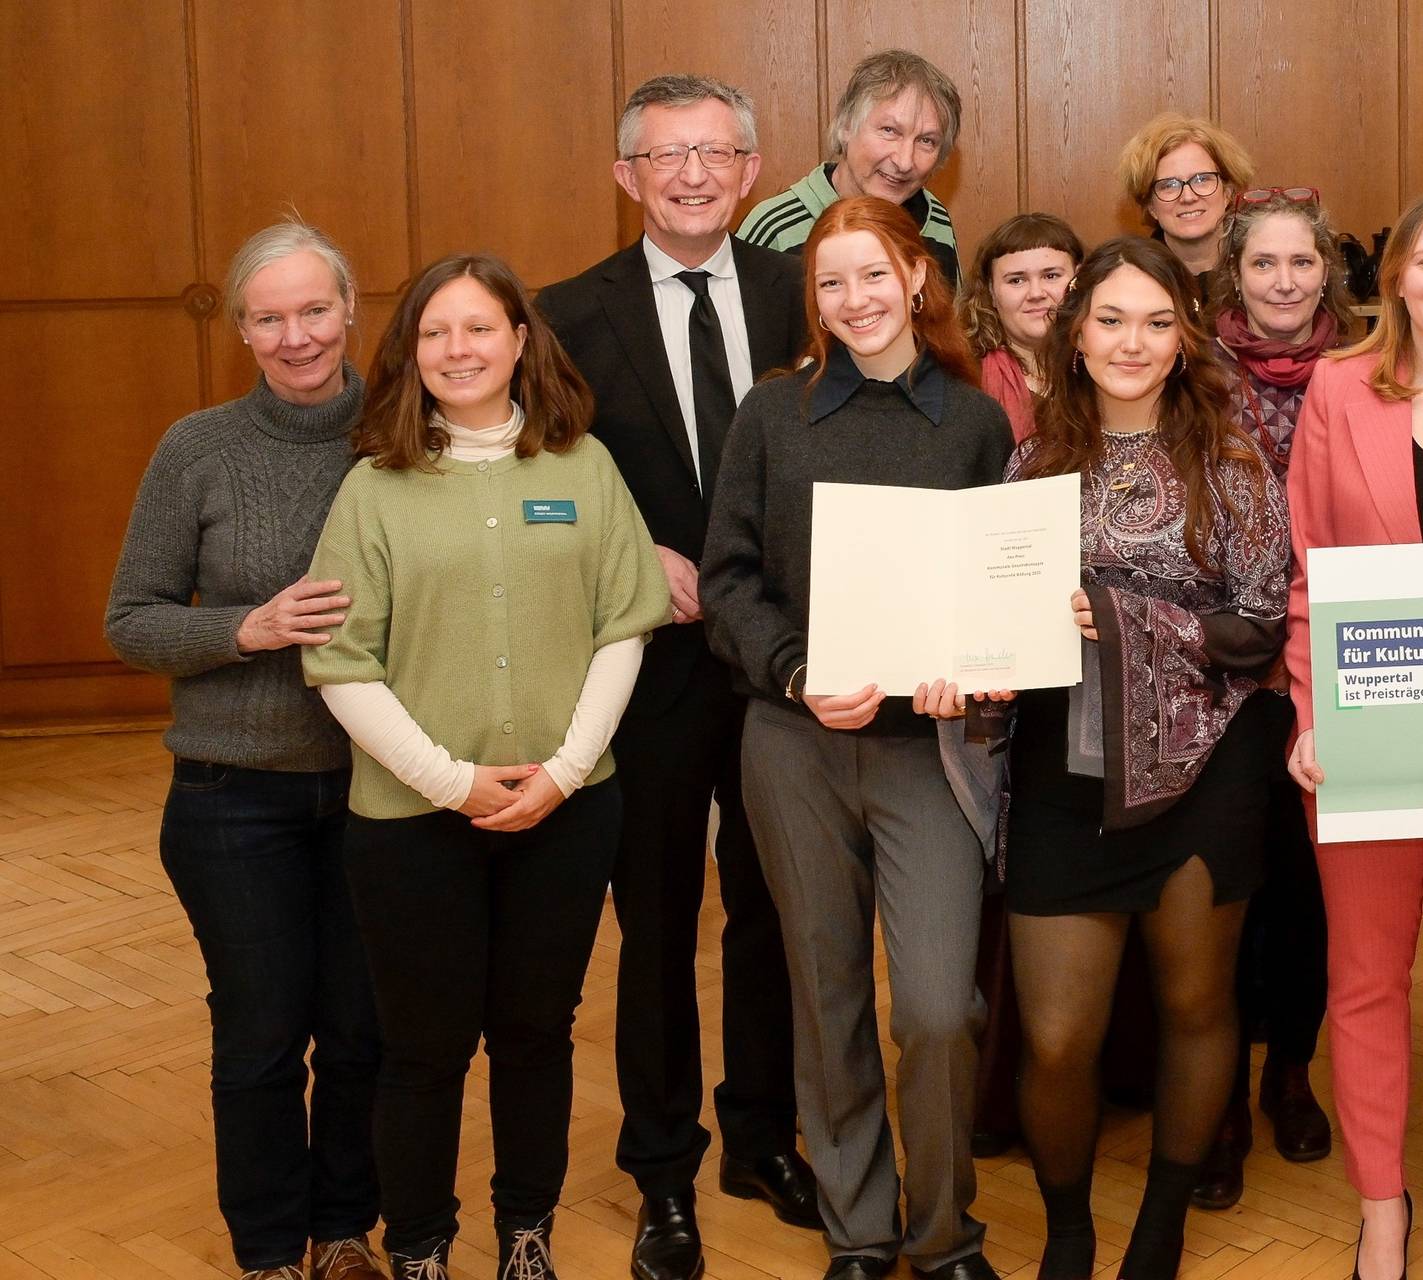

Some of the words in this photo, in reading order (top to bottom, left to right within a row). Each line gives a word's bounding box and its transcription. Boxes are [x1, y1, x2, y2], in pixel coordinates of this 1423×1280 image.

[1343, 647, 1371, 664] für
[1344, 671, 1413, 687] Wuppertal
[1345, 689, 1361, 701] ist
